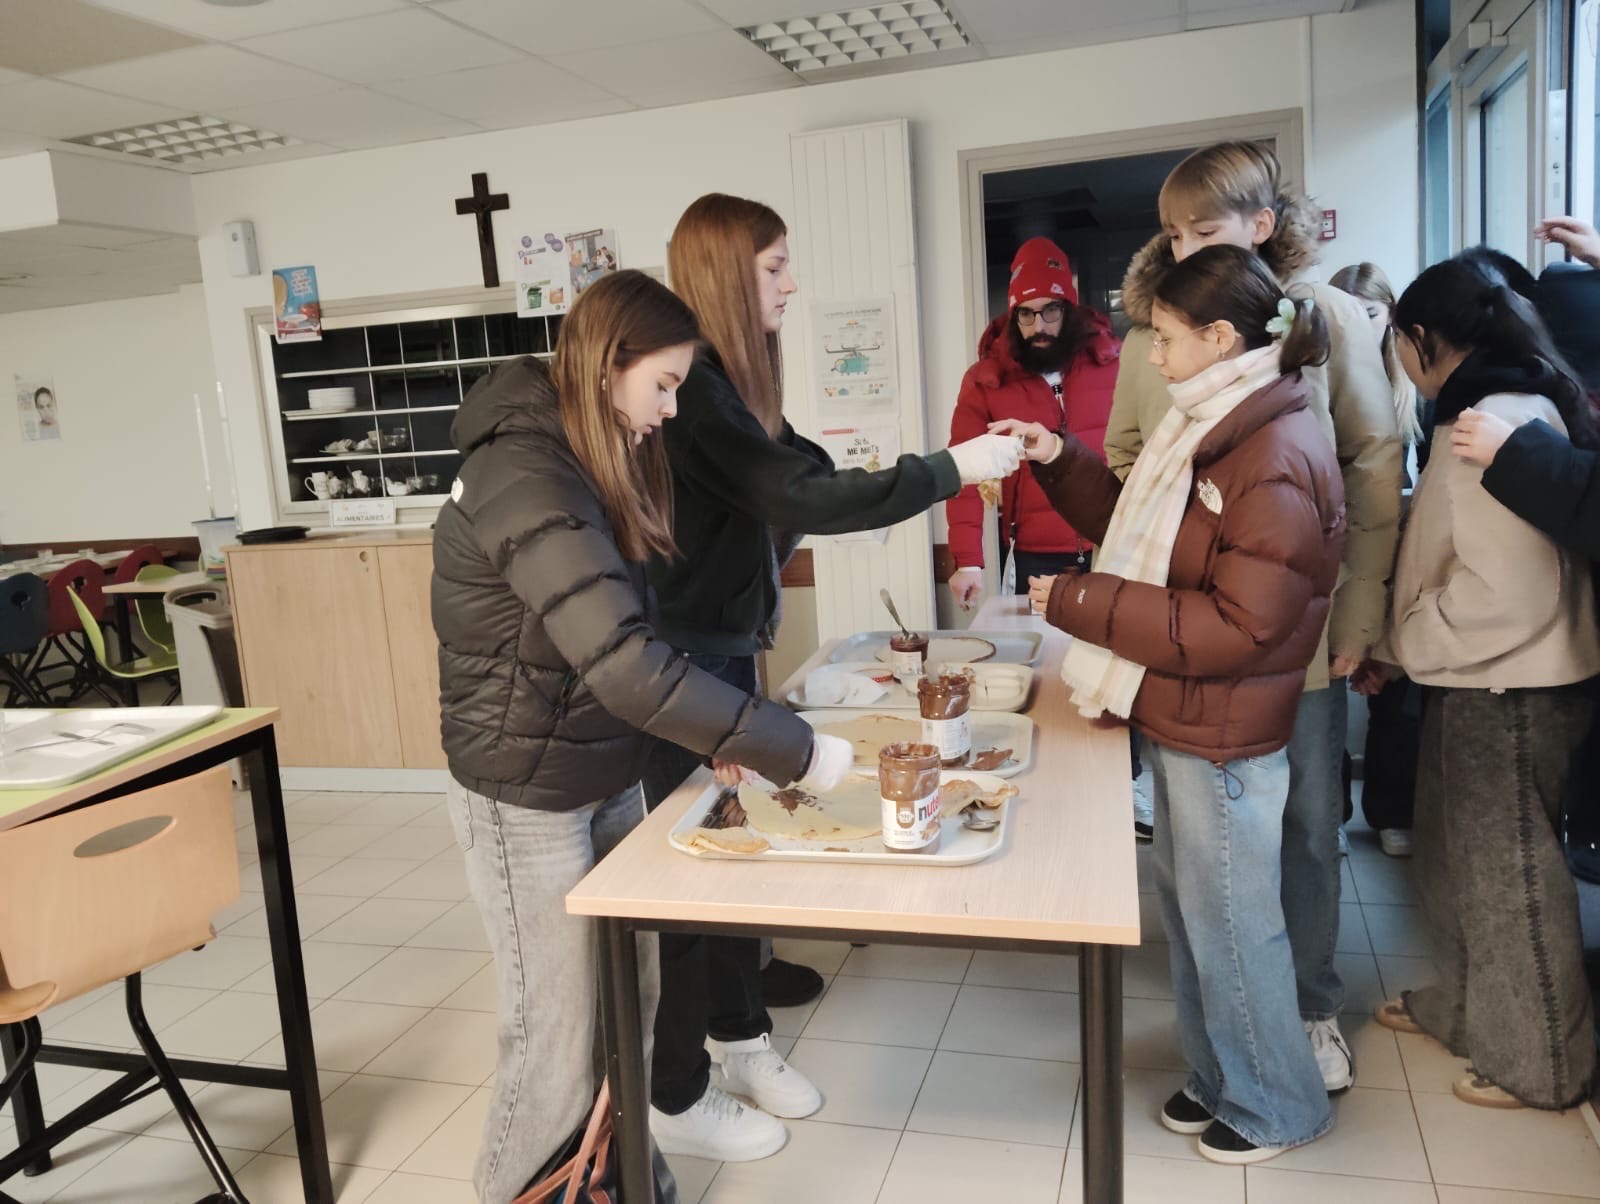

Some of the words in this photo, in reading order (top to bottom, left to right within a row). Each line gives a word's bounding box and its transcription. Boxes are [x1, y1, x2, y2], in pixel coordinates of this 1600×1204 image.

[847, 447, 858, 456] ME
[860, 445, 880, 455] METS
[335, 514, 385, 523] ALIMENTAIRES
